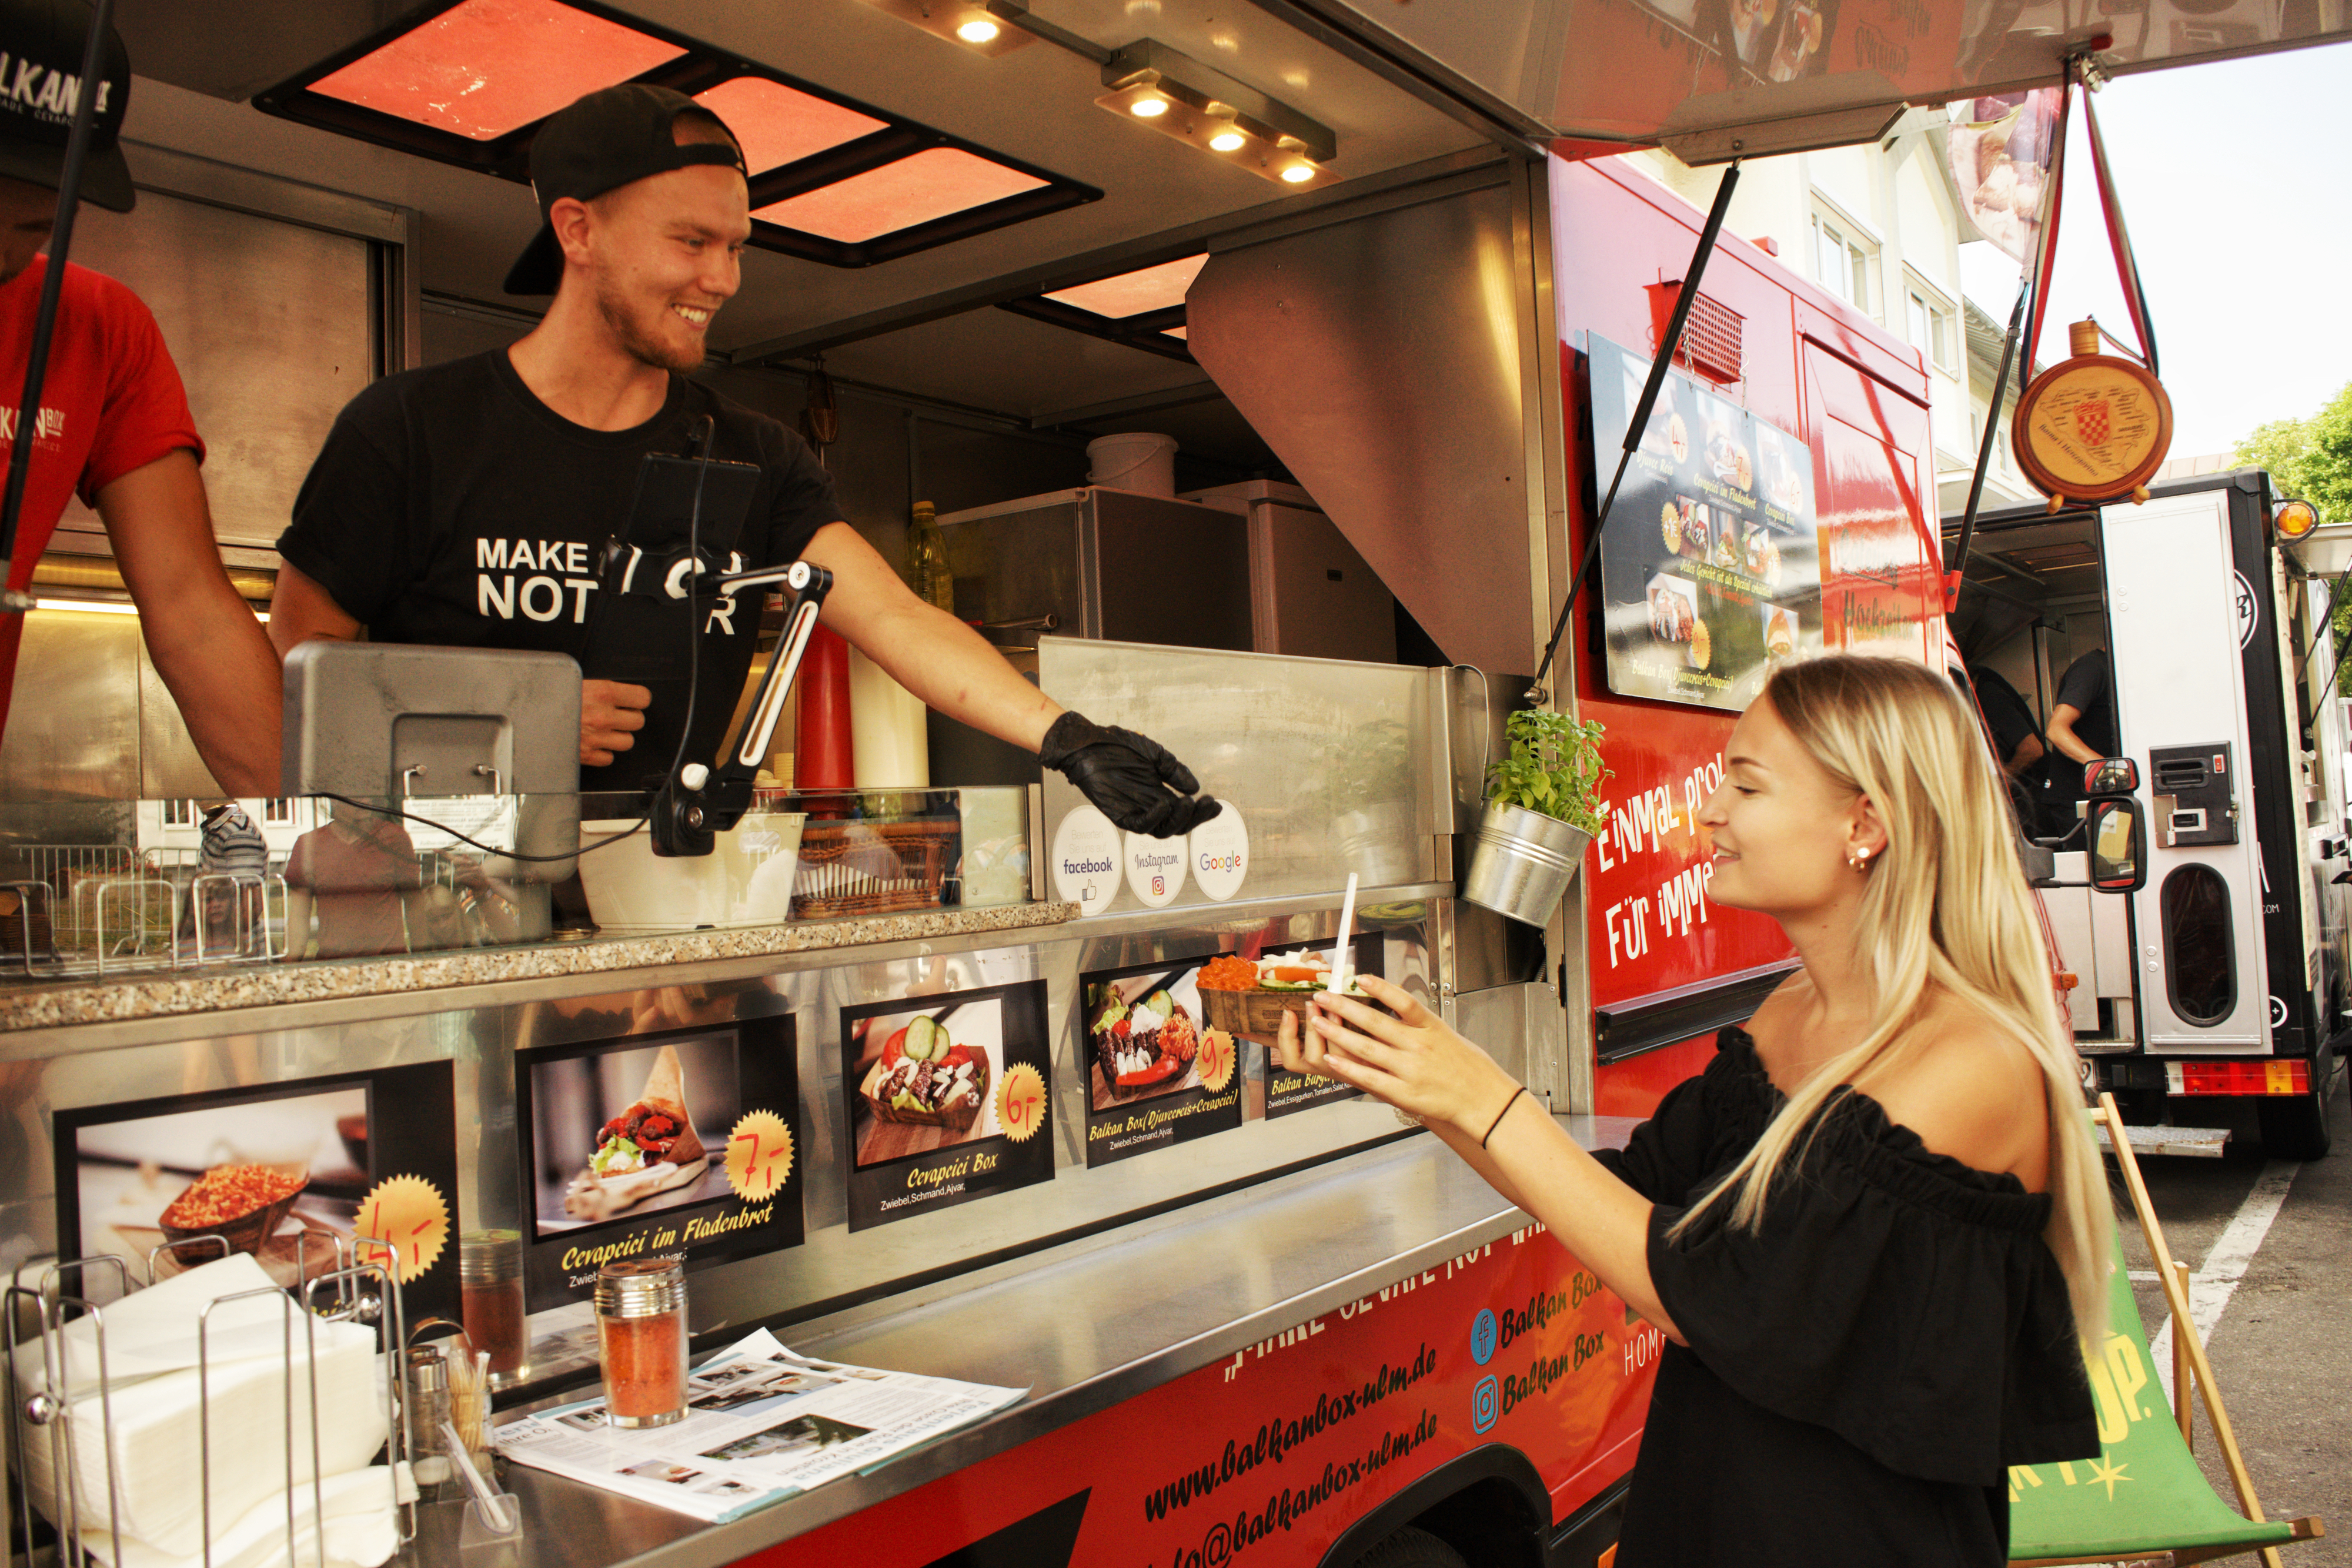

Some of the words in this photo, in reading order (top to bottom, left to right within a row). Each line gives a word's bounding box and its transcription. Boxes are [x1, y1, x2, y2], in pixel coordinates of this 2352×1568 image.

[477, 538, 589, 573] MAKE
[478, 574, 599, 624] NOT
[1071, 830, 1103, 840] Bewerten
[1206, 825, 1232, 834] Bewerten
[1069, 844, 1081, 854] Sie
[1096, 843, 1107, 853] auf
[1139, 841, 1150, 851] Sie
[1064, 857, 1112, 874] facebook
[1135, 852, 1180, 872] Instagram
[1200, 850, 1241, 873] Google
[1271, 1076, 1301, 1095] Balkan
[1089, 1122, 1123, 1141] Balkan
[907, 1155, 970, 1188] Cevapcici
[973, 1153, 998, 1172] Box
[562, 1230, 648, 1271] Cevapcici
[652, 1226, 676, 1249] im
[683, 1202, 774, 1242] Fladenbrot
[1501, 1292, 1567, 1349] Balkan
[1502, 1355, 1568, 1415] Balkan
[1573, 1330, 1604, 1372] Box
[1145, 1342, 1436, 1523] www.balkanbox-ulm.de
